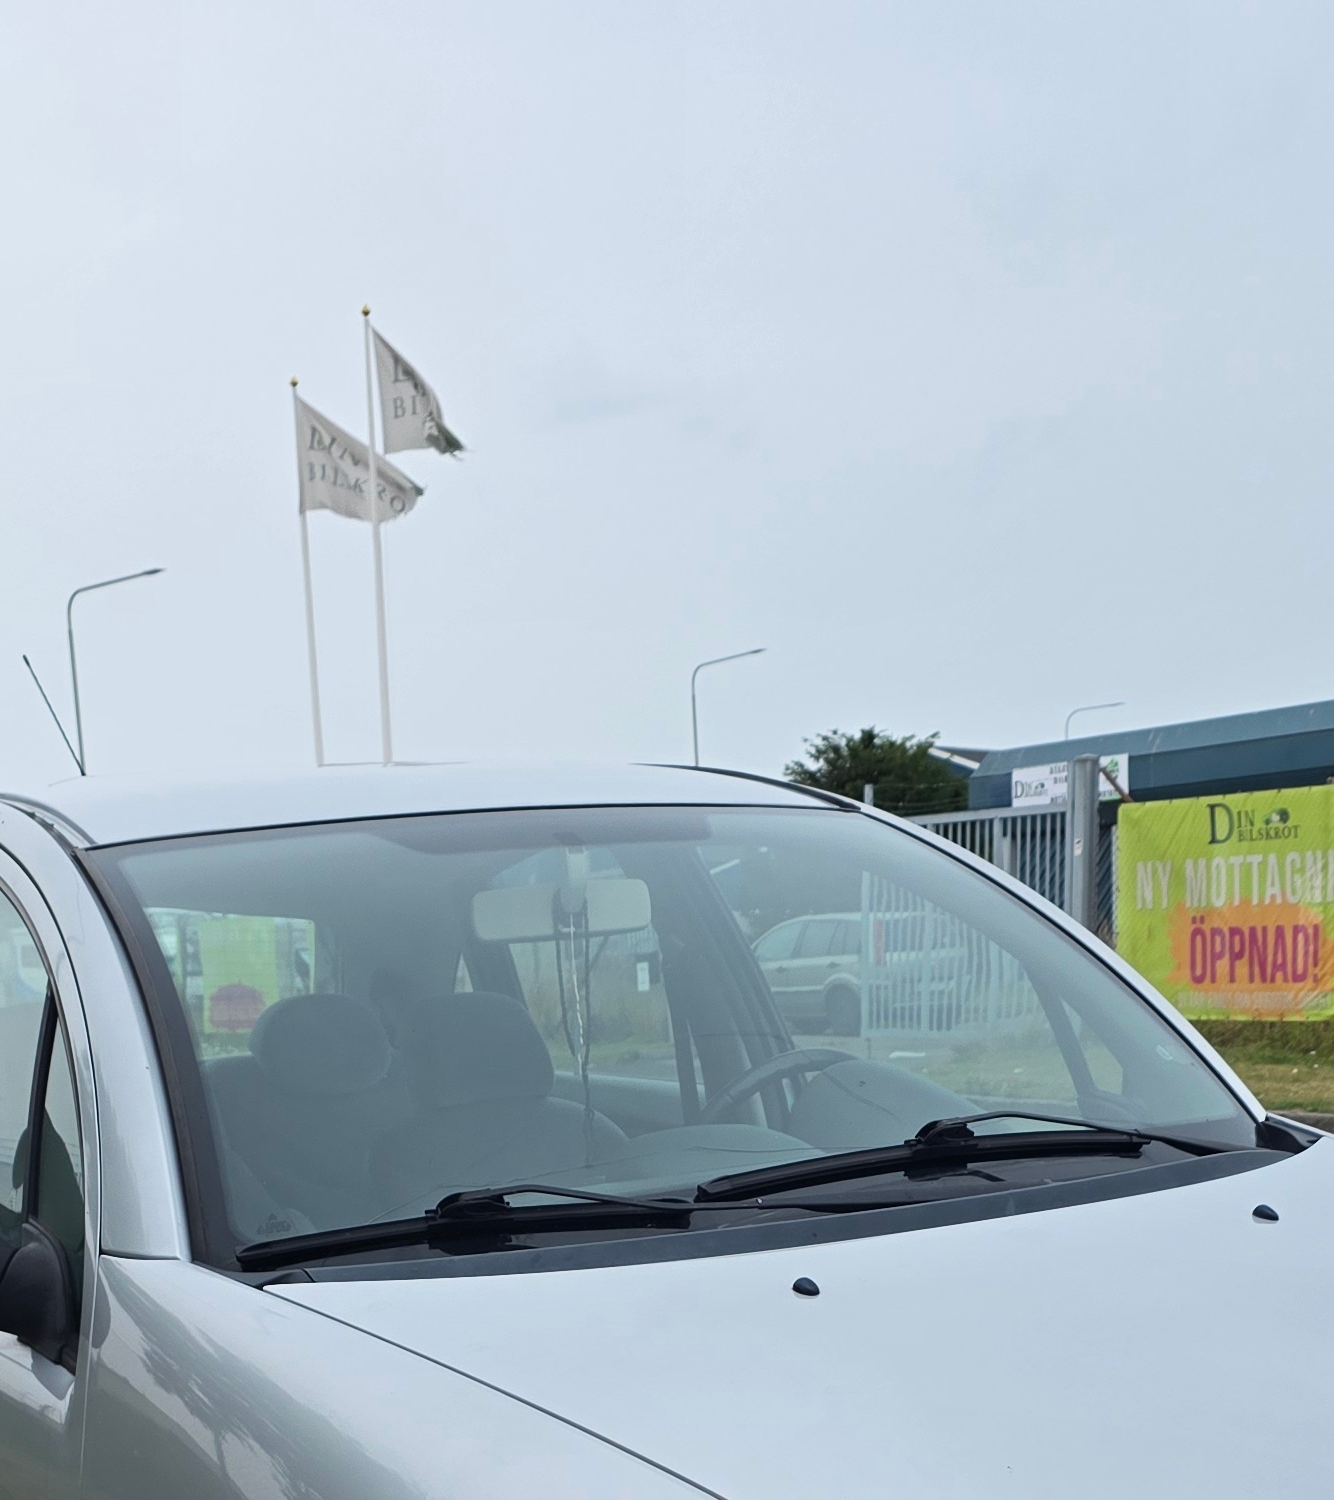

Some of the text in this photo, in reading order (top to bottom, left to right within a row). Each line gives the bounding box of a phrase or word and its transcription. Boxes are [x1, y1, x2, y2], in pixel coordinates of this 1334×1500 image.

[1206, 802, 1256, 845] DIN
[1237, 823, 1301, 844] BILSKROT
[1136, 859, 1172, 911] NY
[1189, 914, 1320, 985] ÖPPNAD!
